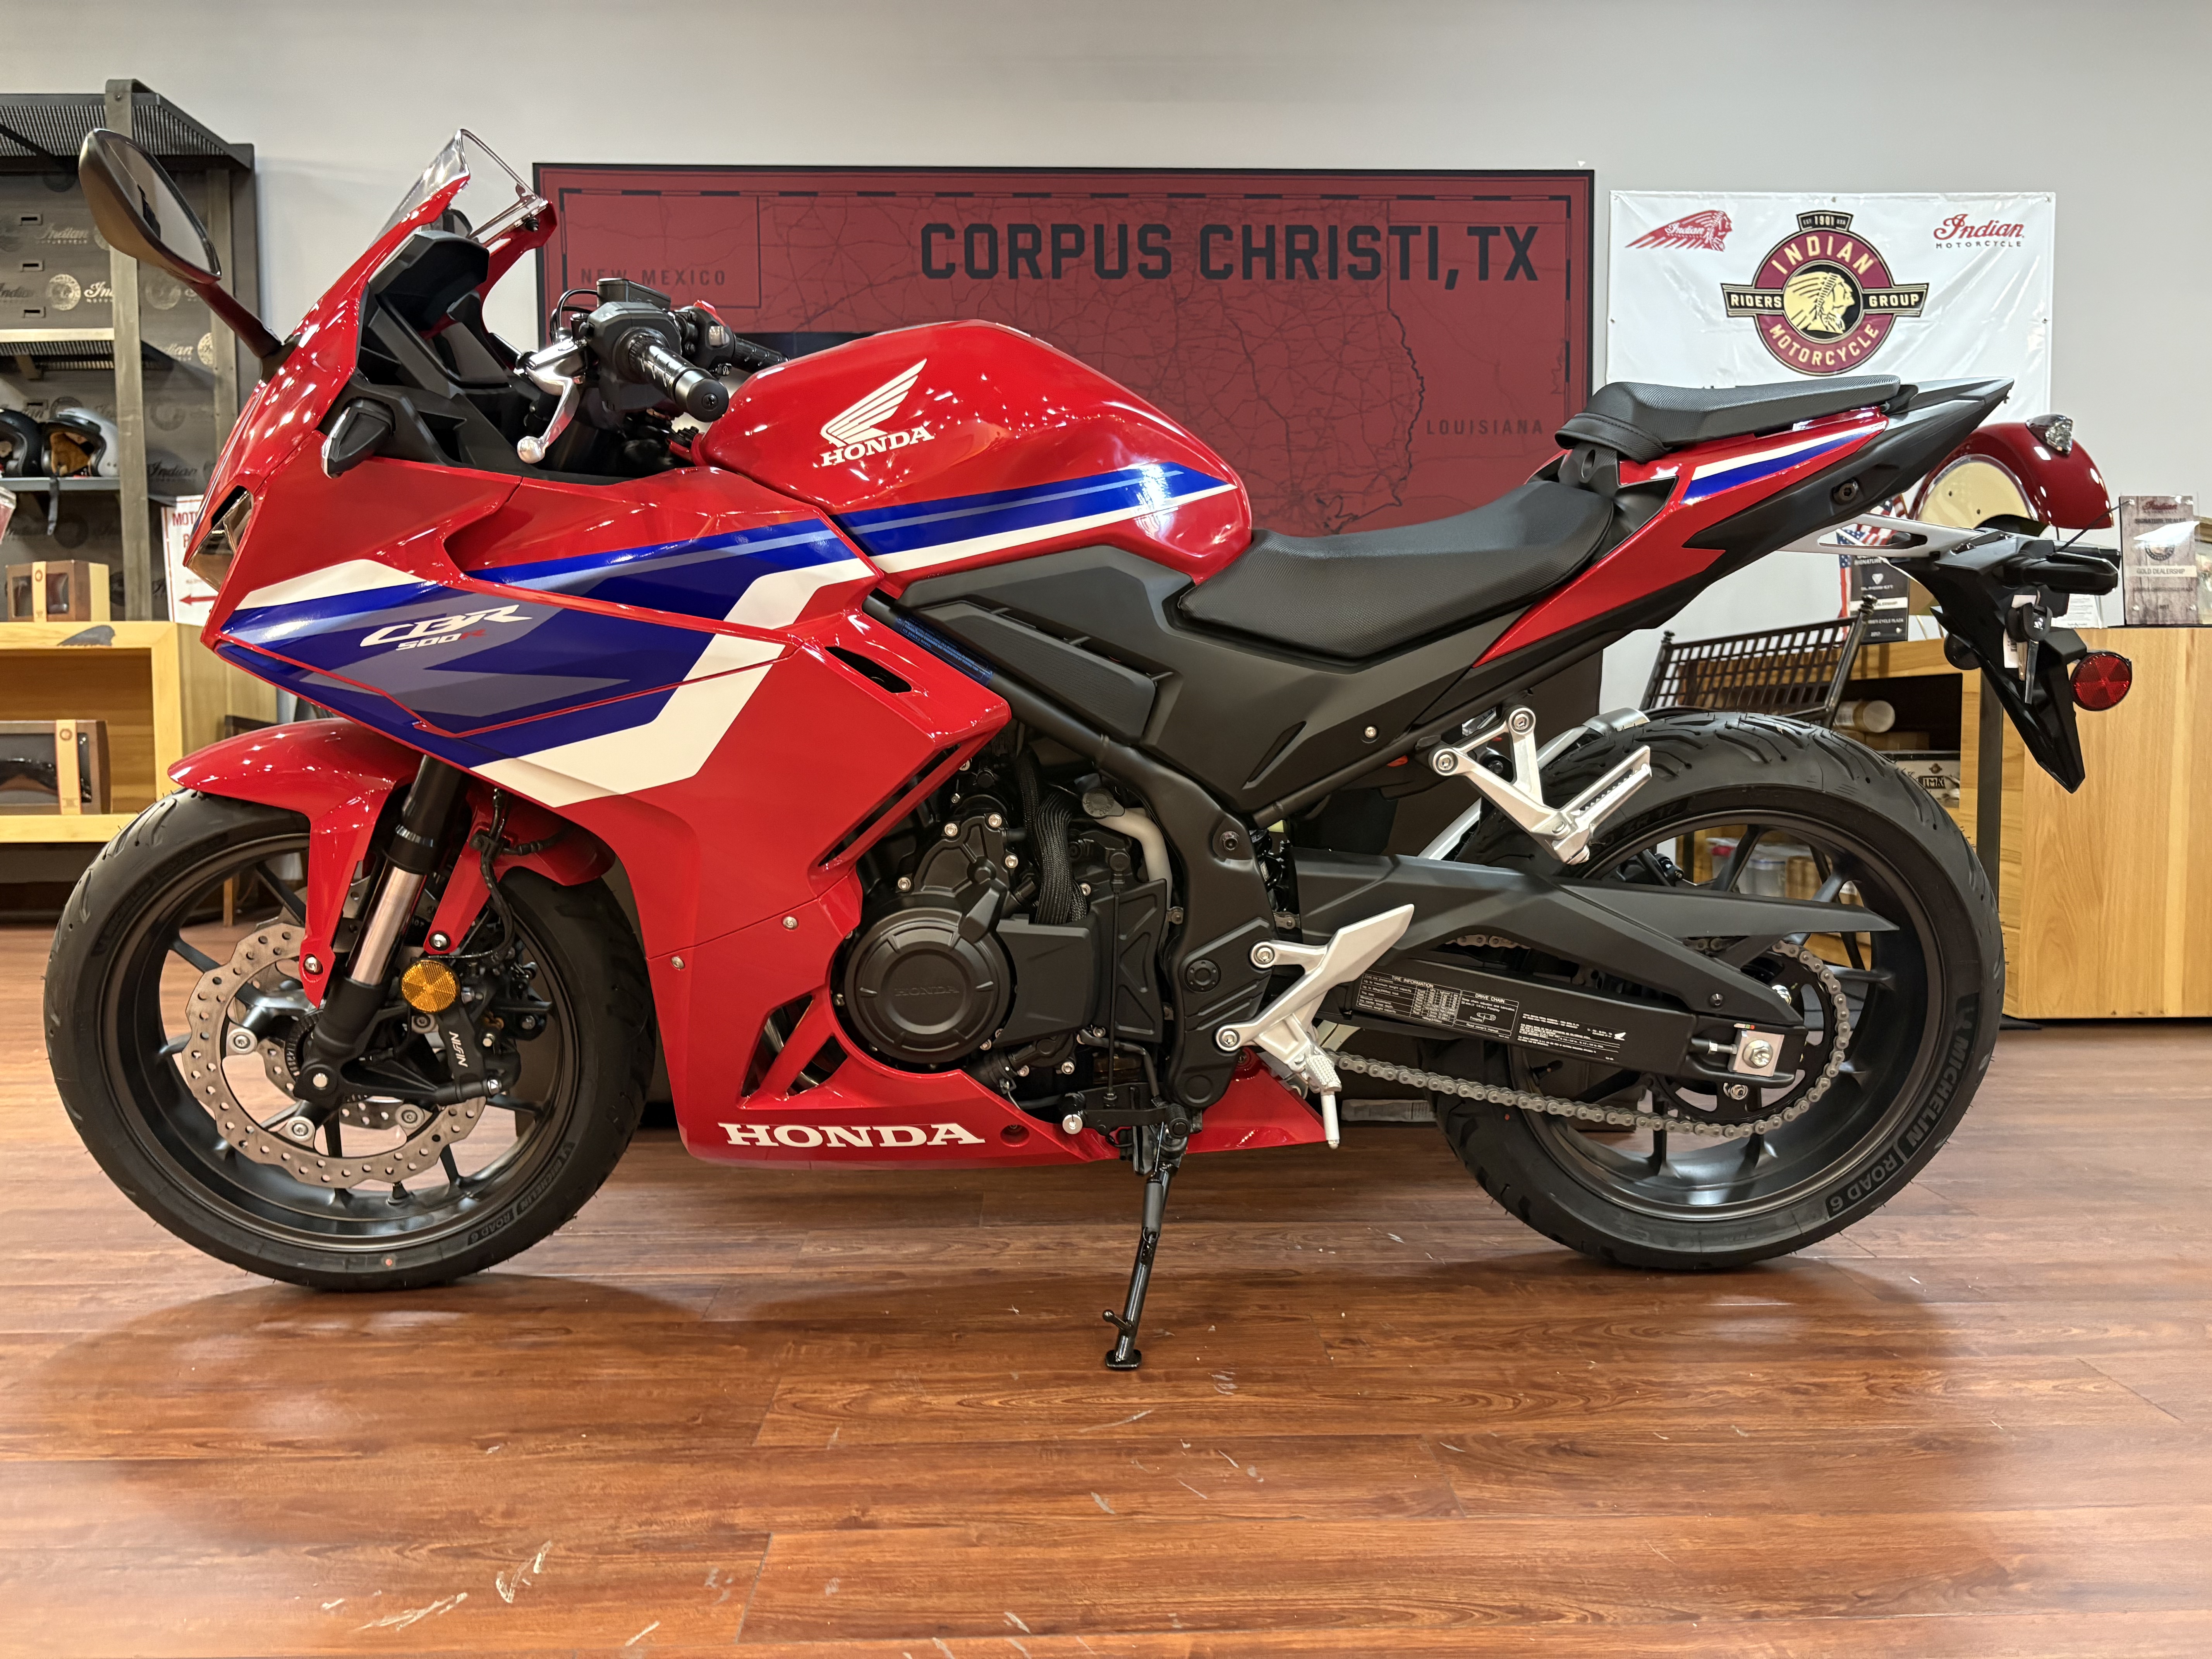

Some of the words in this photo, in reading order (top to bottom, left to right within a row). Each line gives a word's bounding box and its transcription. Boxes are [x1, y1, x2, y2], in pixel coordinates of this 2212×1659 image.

[1665, 222, 1705, 234] Indian
[1814, 216, 1834, 225] 1901
[1933, 214, 2024, 240] Indian
[921, 223, 1172, 280] CORPUS
[1771, 235, 1874, 275] INDIAN
[1936, 240, 2021, 249] MOTORCYCLE
[642, 269, 725, 286] MEXICO
[1730, 294, 1782, 308] RIDERS
[1869, 294, 1919, 307] GROUP
[1769, 323, 1879, 366] MOTORCYCLE
[1427, 420, 1543, 434] LOUISIANA
[819, 425, 935, 467] HONDA
[359, 605, 532, 647] CBR
[395, 629, 486, 651] 500R
[1403, 978, 1434, 988] INFORMATION
[1905, 1037, 1970, 1148] MICHELIN
[718, 1122, 986, 1148] HONDA
[1847, 1153, 1902, 1200] ROAD
[1829, 1196, 1844, 1212] 6
